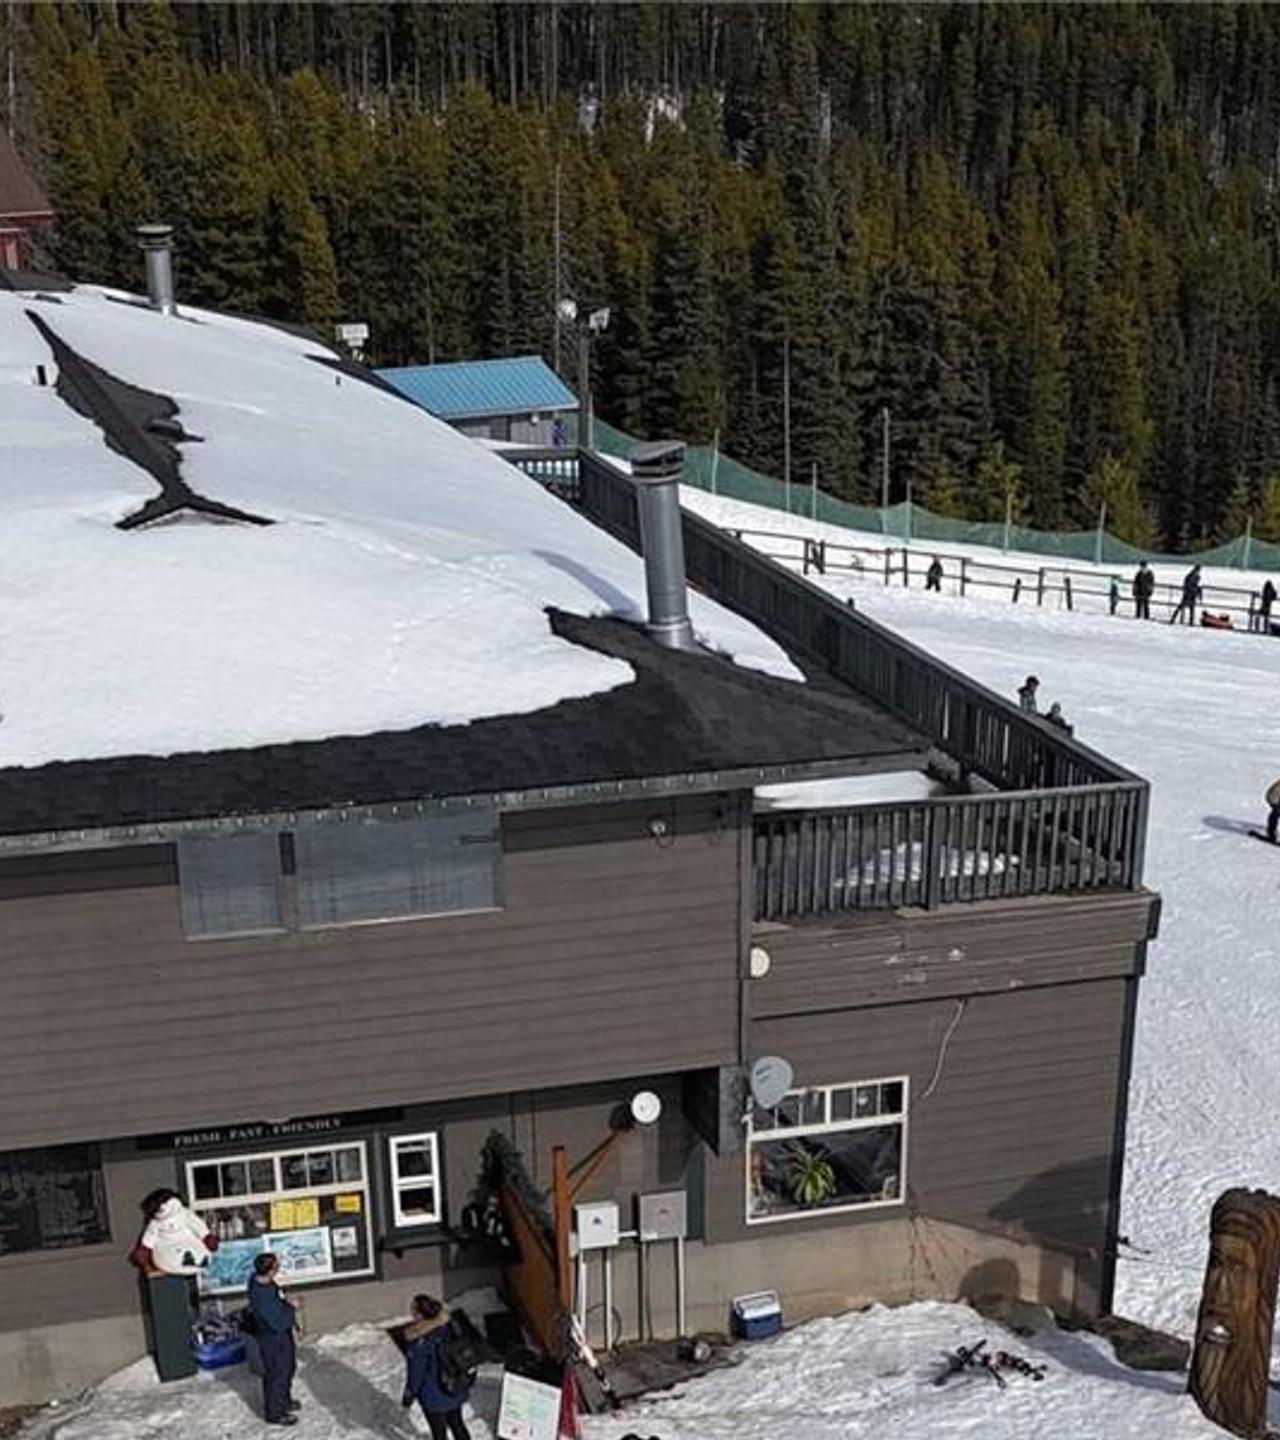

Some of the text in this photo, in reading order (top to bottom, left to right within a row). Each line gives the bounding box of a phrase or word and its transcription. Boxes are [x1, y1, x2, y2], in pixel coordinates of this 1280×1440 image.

[173, 1117, 342, 1147] FRESH FAST FRIENDLY
